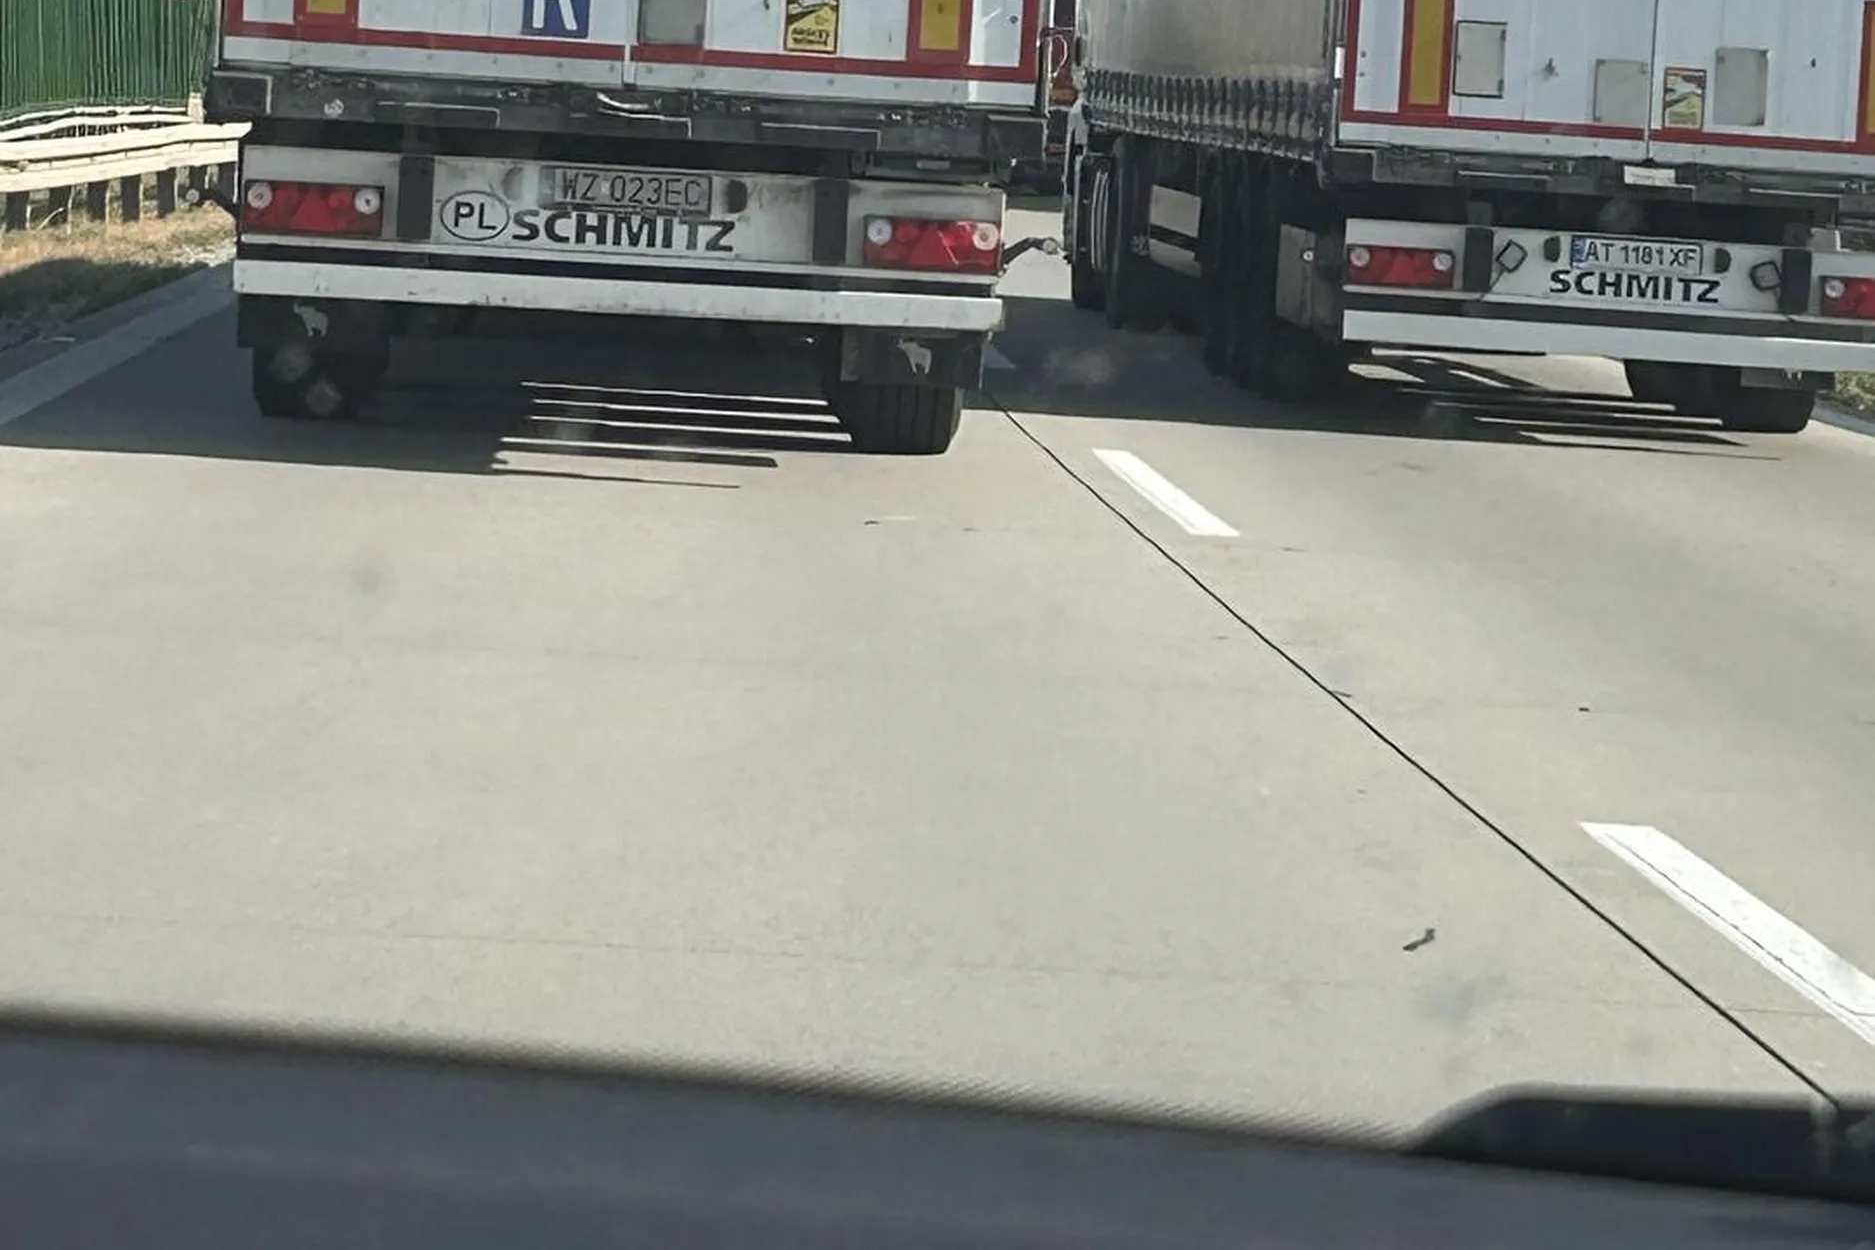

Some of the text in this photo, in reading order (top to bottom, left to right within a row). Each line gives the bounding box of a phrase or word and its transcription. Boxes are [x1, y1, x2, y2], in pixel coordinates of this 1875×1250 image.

[562, 170, 701, 206] WZ 023EC
[454, 201, 498, 230] PL
[512, 210, 735, 252] SCHMITZ
[1585, 241, 1615, 263] AT
[1549, 269, 1721, 303] SCHMITZ
